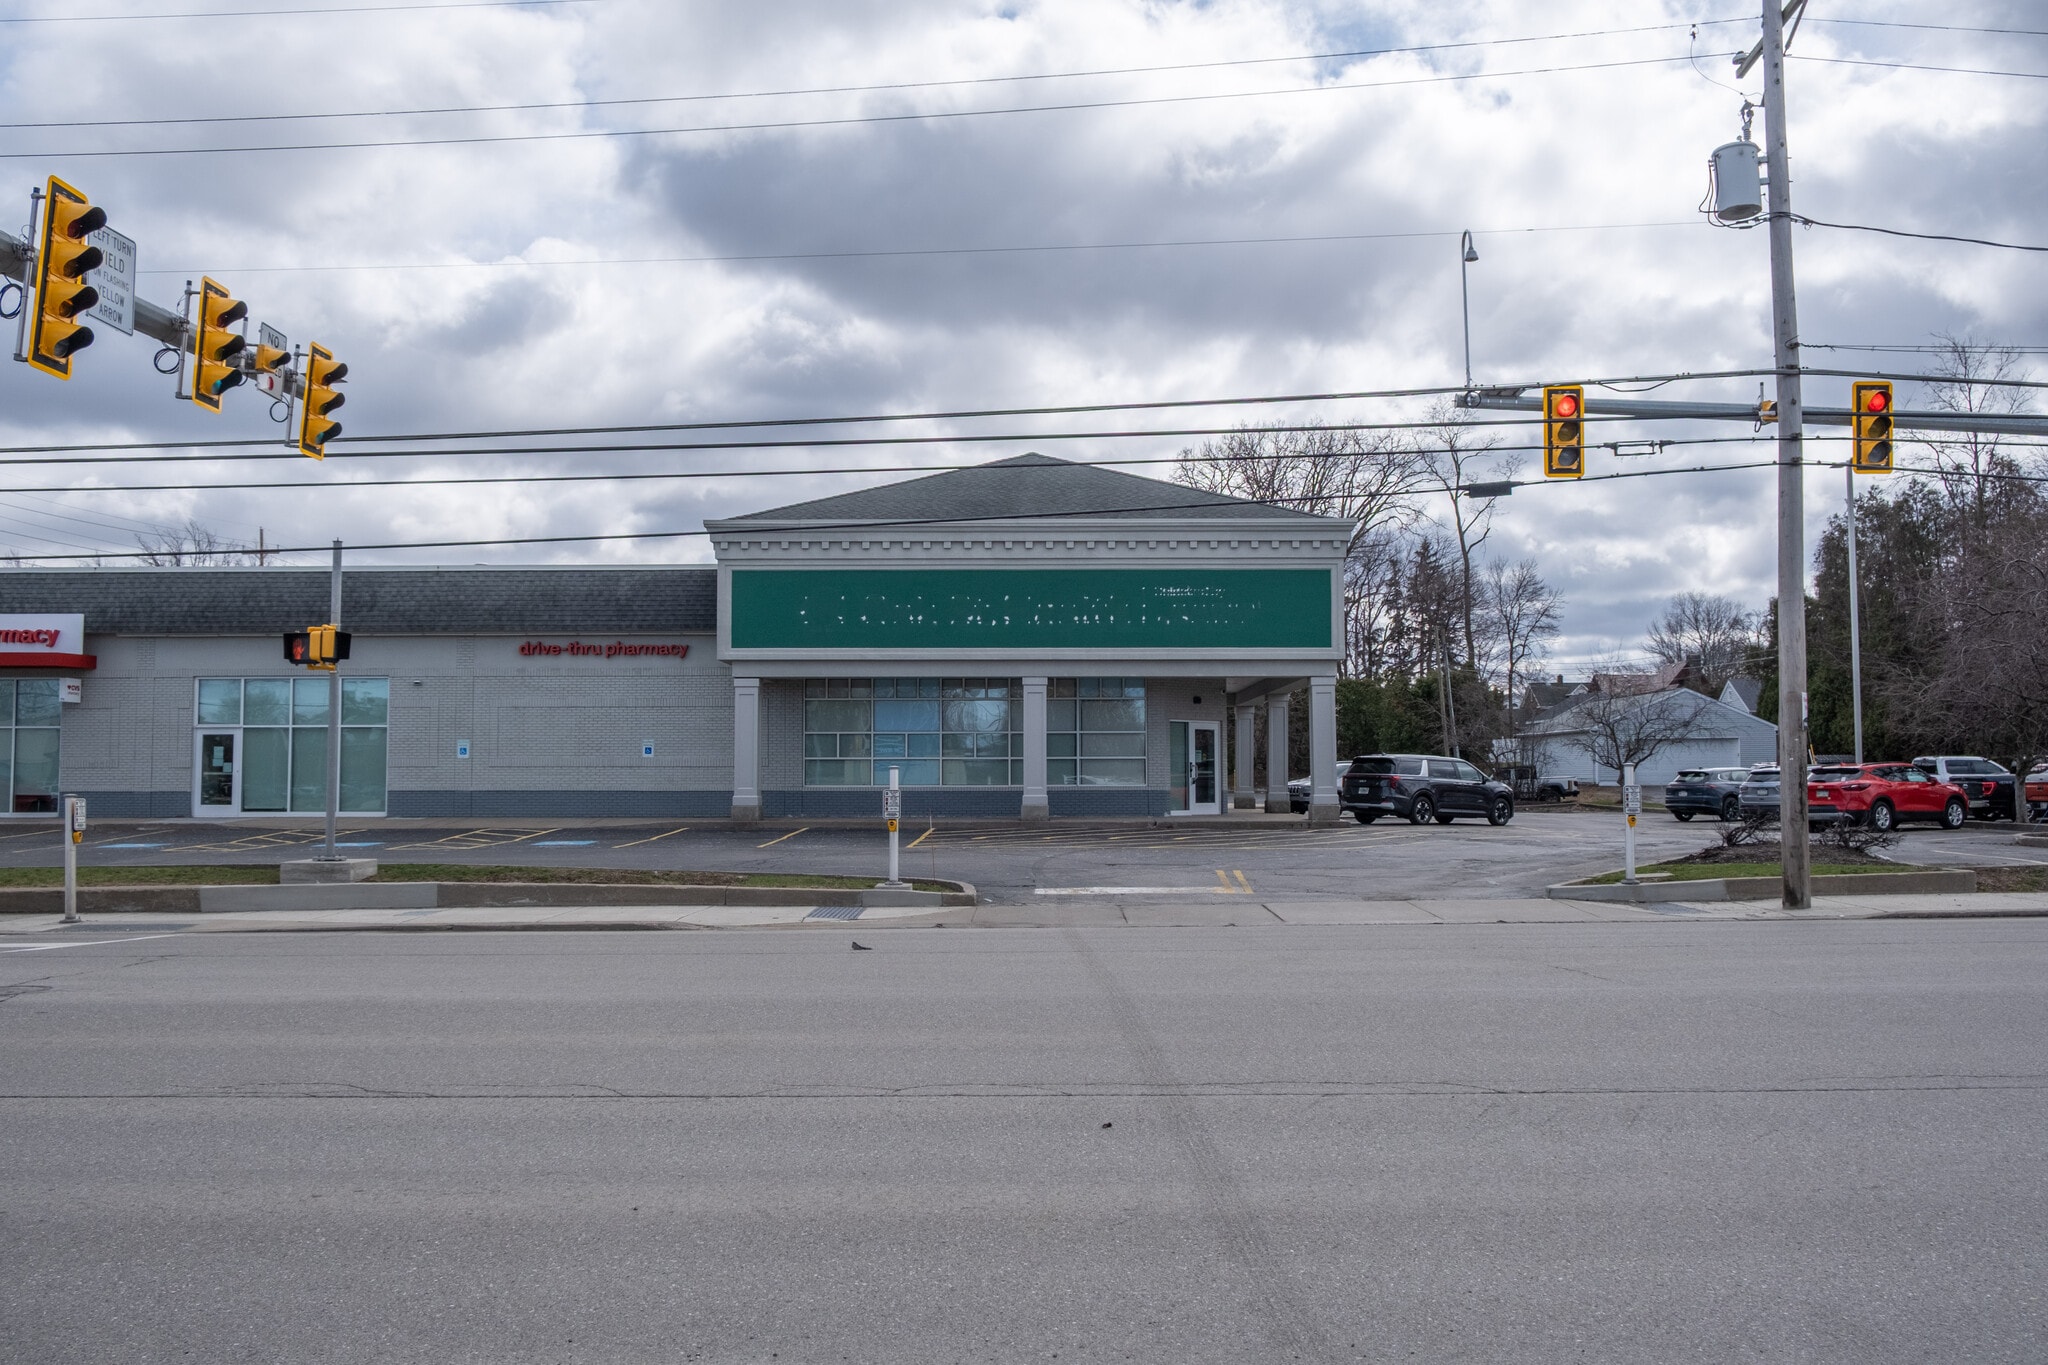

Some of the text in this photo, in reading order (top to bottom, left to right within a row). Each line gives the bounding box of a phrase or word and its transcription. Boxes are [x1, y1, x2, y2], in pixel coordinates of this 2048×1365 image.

[93, 228, 131, 257] LEFT TURN
[103, 271, 129, 292] FLASHING
[98, 284, 124, 307] YELLOW
[99, 304, 123, 324] ARROW
[268, 332, 279, 348] NO
[0, 629, 61, 648] macy
[518, 641, 689, 658] drive-thru pharmacy
